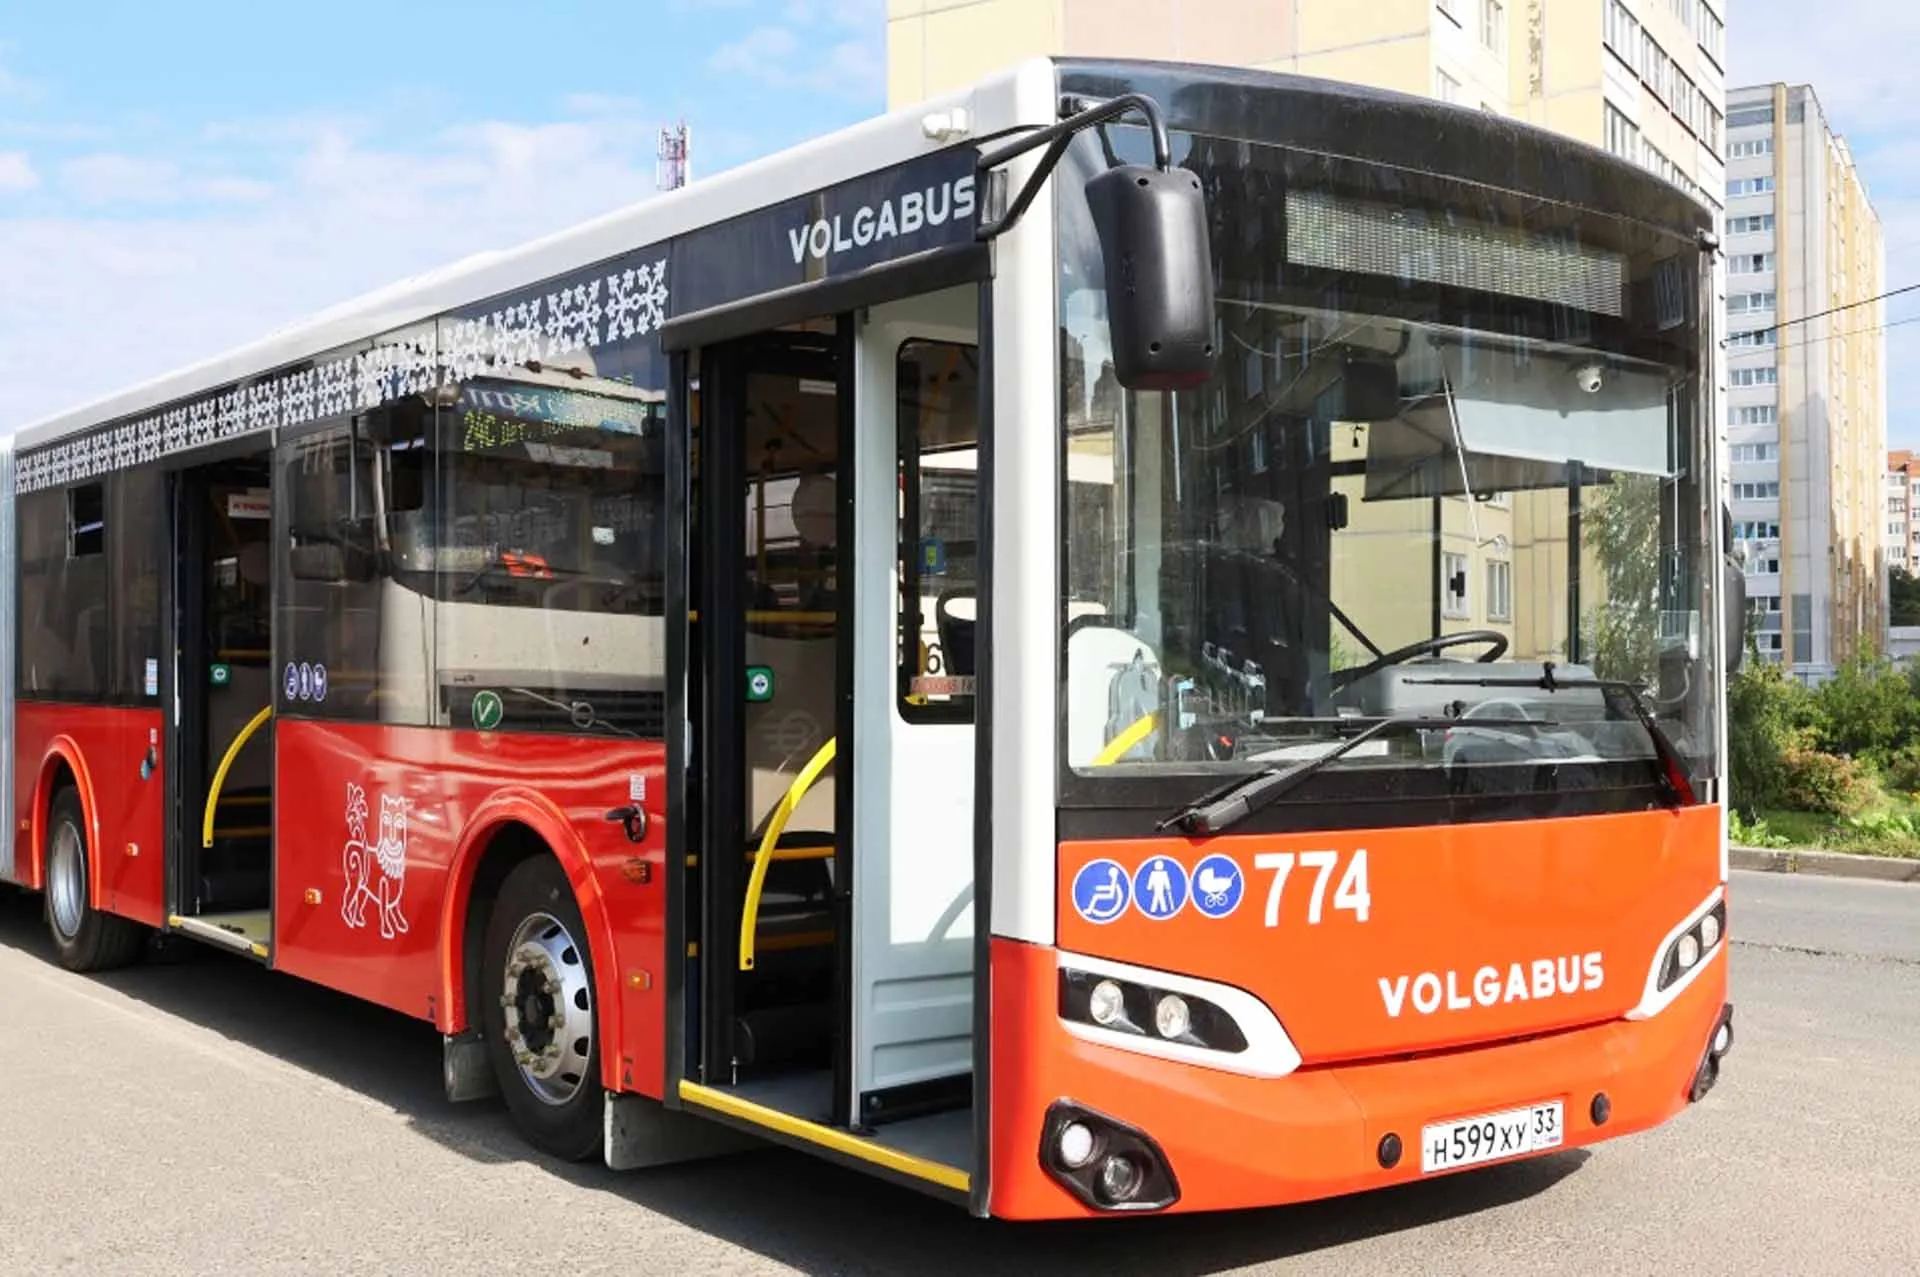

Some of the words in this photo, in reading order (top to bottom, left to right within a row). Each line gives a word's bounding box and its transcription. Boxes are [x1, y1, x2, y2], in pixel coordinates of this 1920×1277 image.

[788, 174, 975, 264] VOLGABUS
[1254, 849, 1371, 928] 774
[1378, 951, 1604, 1017] VOLGABUS
[1534, 1107, 1556, 1135] 33
